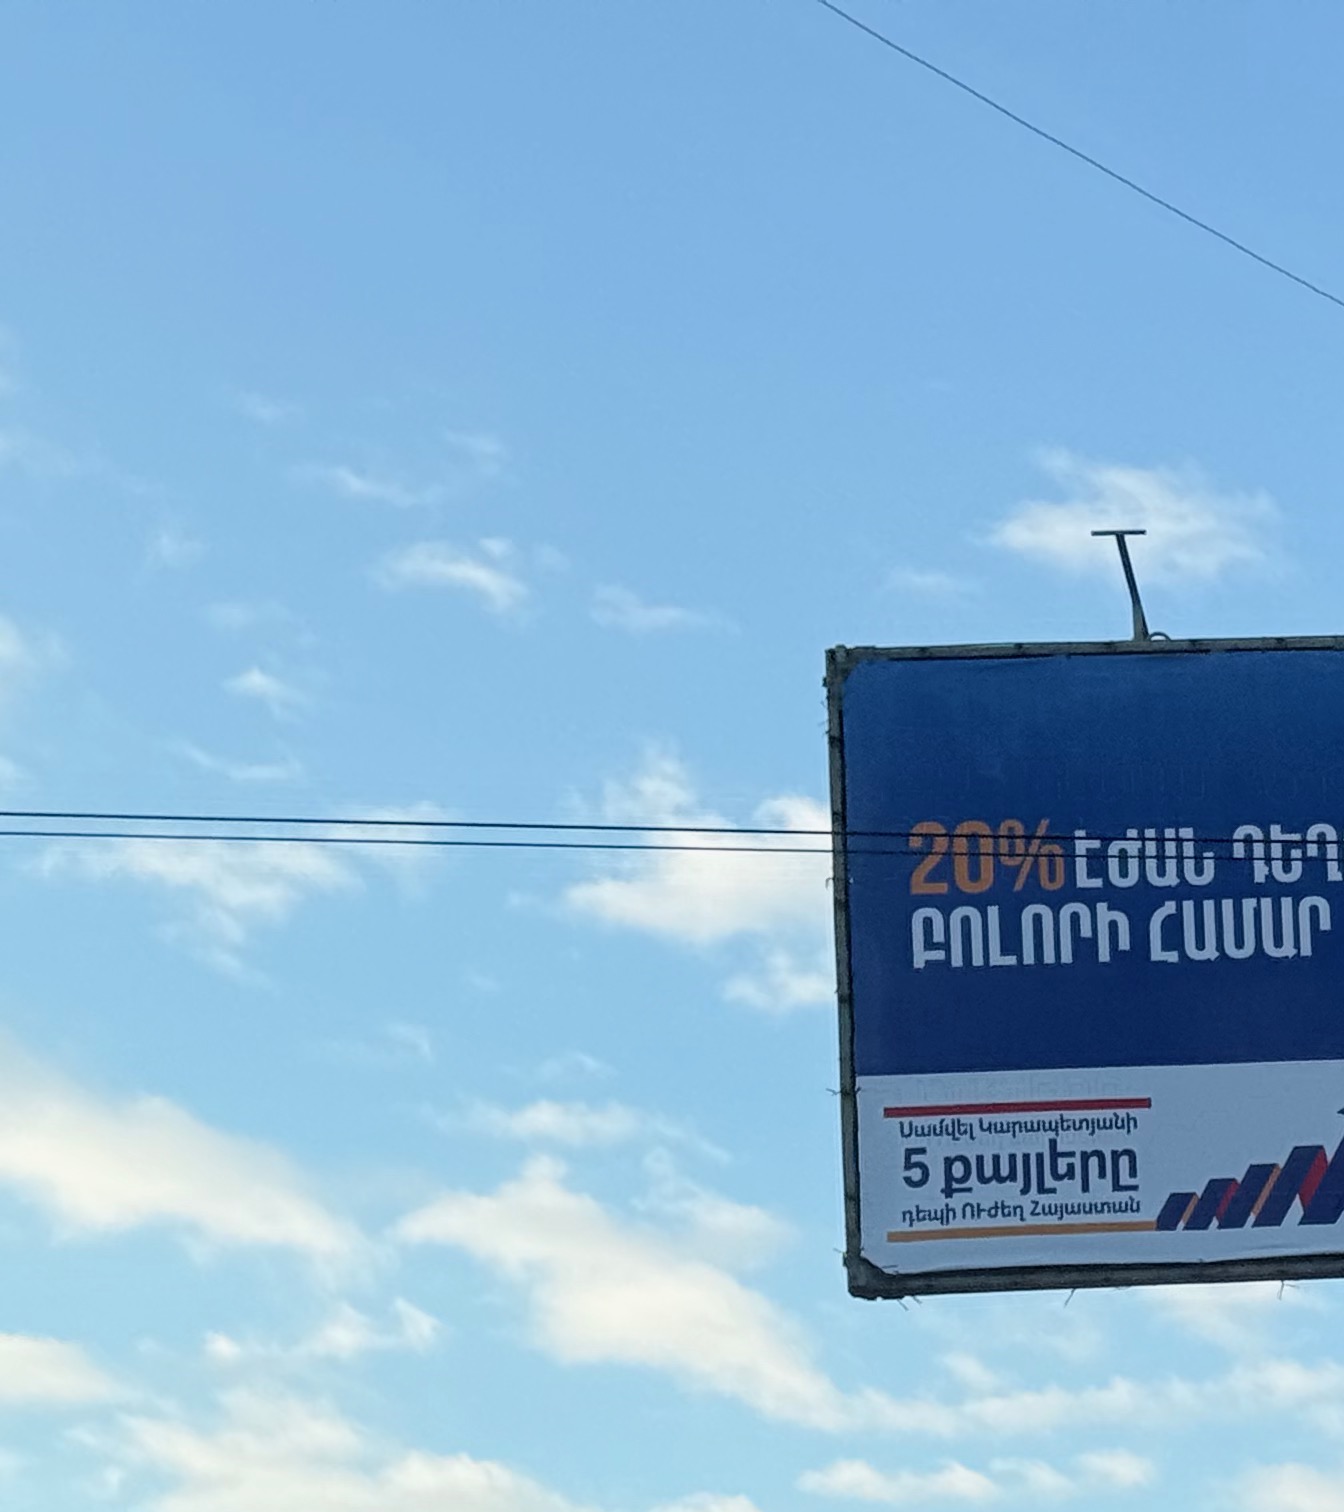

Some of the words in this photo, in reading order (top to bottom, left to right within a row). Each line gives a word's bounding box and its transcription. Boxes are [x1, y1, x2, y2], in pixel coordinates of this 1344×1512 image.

[908, 818, 1065, 895] 20%
[1074, 827, 1216, 890] ԷԺԱՆ
[911, 898, 1131, 969] ԲՈԼՈՐԻ
[1148, 896, 1332, 963] ՀԱՄԱՐ
[898, 1117, 975, 1141] Սամվել
[979, 1112, 1138, 1138] Կարապետյանի
[902, 1147, 931, 1189] 5
[940, 1138, 1139, 1199] քայլերը
[902, 1204, 957, 1228] դեպի
[1029, 1196, 1142, 1221] Հայաստան
